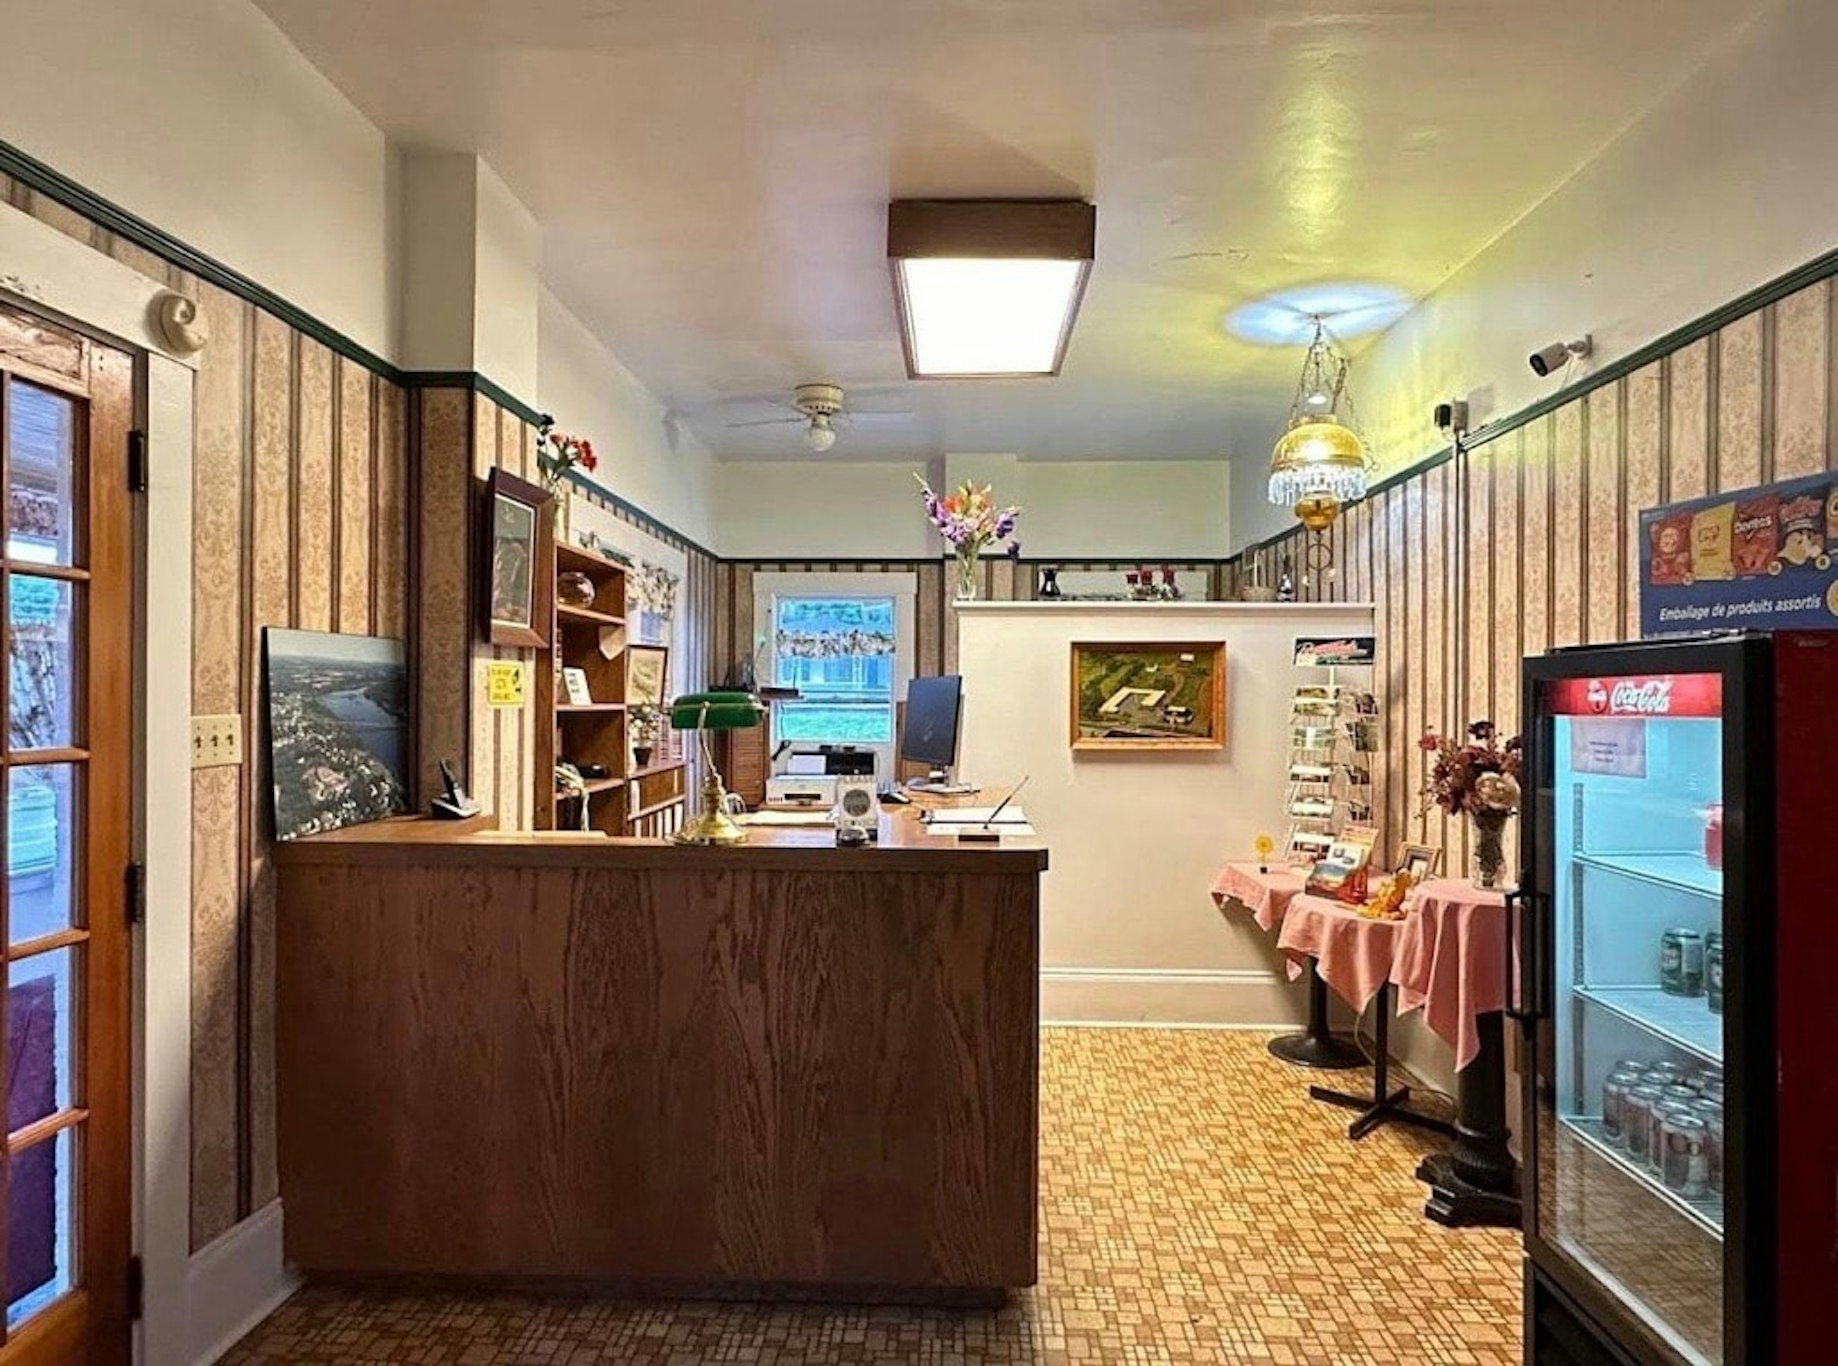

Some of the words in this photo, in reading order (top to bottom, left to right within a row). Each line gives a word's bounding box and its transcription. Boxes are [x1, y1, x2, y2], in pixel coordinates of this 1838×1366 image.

[1659, 604, 1710, 621] Emballage
[1711, 602, 1724, 617] de
[1726, 598, 1773, 618] produits
[1774, 594, 1821, 611] assortis
